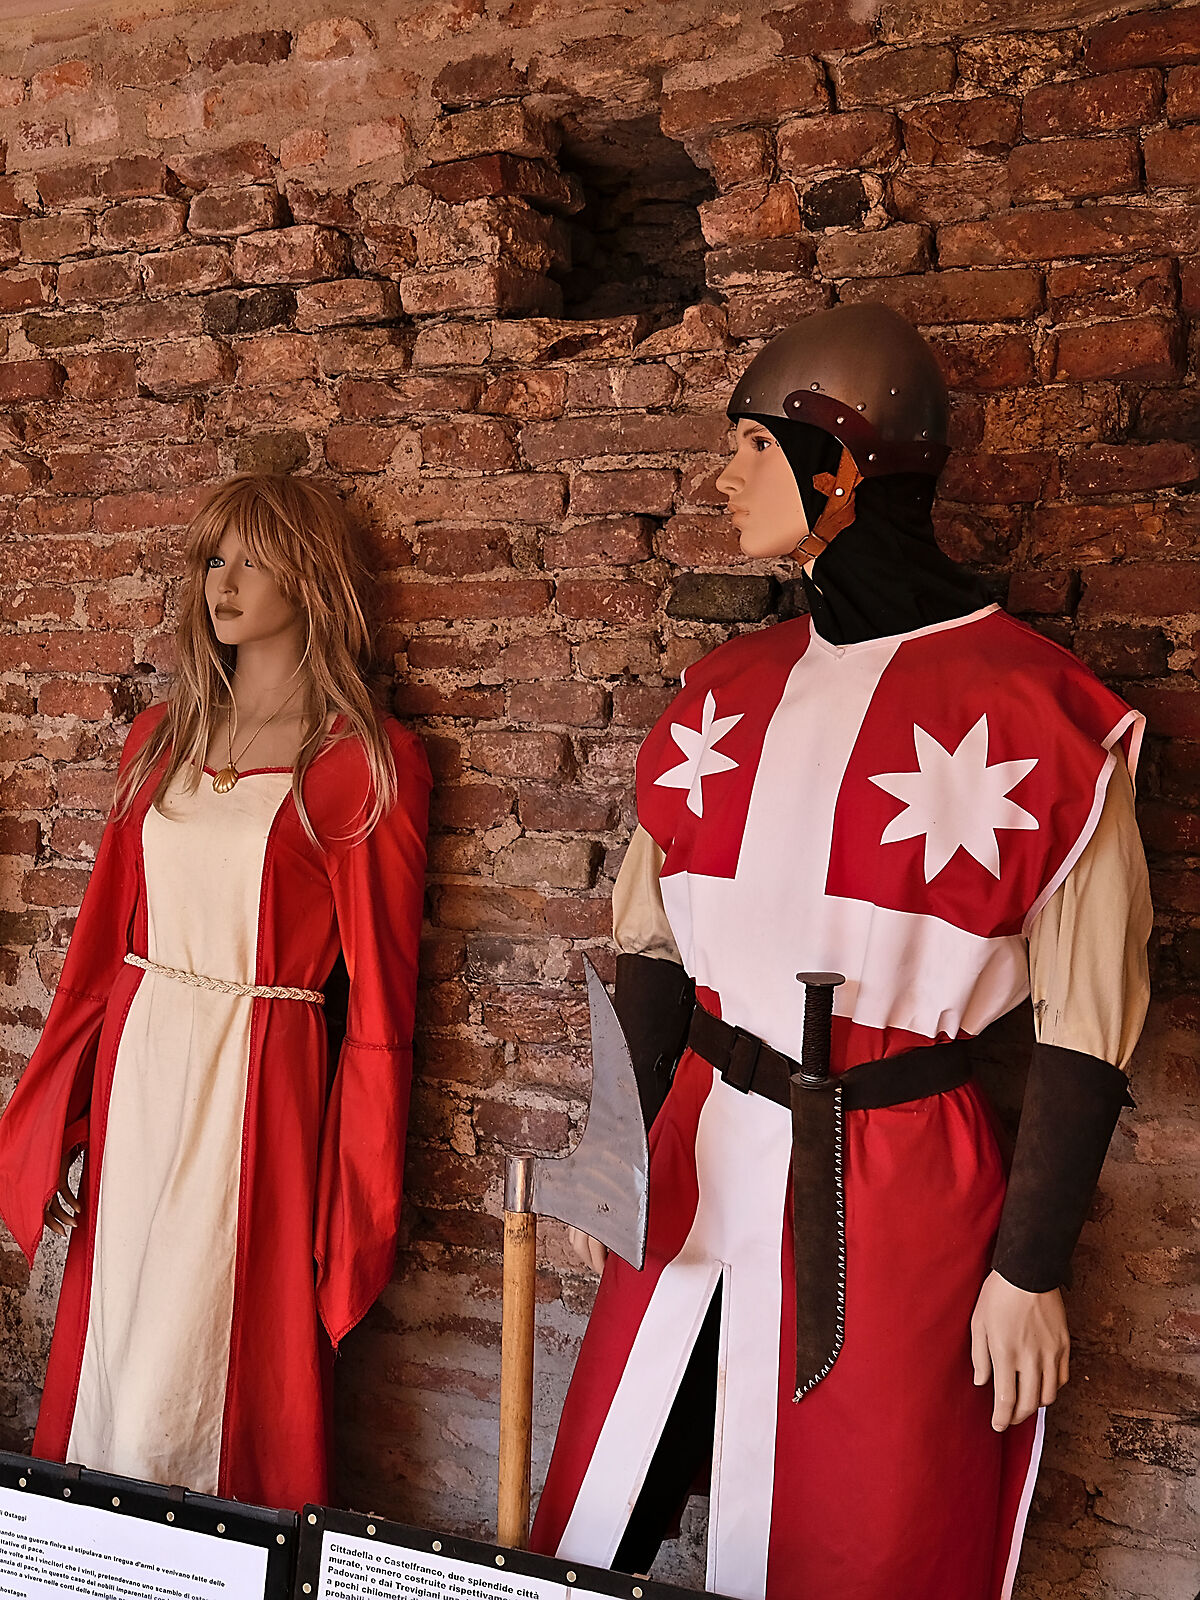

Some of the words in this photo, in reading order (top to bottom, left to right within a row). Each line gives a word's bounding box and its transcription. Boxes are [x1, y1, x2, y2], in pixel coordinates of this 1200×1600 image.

[4, 1511, 27, 1522] Ostaggi
[27, 1546, 45, 1555] pace.
[28, 1537, 49, 1546] guerra
[49, 1540, 67, 1550] finiva
[74, 1548, 103, 1559] stipulava
[113, 1556, 134, 1566] tregua
[161, 1568, 191, 1579] venivano
[191, 1574, 208, 1584] fatte
[208, 1578, 226, 1588] delle
[8, 1551, 24, 1559] volte
[25, 1554, 34, 1562] sia
[39, 1558, 64, 1569] vincitori
[64, 1564, 77, 1572] che
[81, 1568, 97, 1578] vinti,
[142, 1583, 154, 1591] uno
[155, 1586, 183, 1597] scambio
[23, 1564, 40, 1574] pace,
[48, 1570, 70, 1580] questo
[70, 1576, 86, 1584] caso
[97, 1582, 115, 1591] nobili
[24, 1574, 43, 1583] vivere
[43, 1579, 59, 1587] nelle
[59, 1583, 75, 1591] corti
[75, 1586, 91, 1595] delle
[327, 1565, 368, 1582] Padovani
[378, 1578, 393, 1588] dai
[395, 1581, 441, 1600] Trevigiani
[328, 1556, 363, 1571] murate,
[365, 1565, 402, 1579] vennero
[404, 1574, 447, 1590] costruite
[330, 1543, 374, 1561] Cittadella
[384, 1556, 445, 1579] Castelfranco,
[447, 1571, 466, 1583] due
[468, 1577, 514, 1594] splendide
[516, 1588, 539, 1600] città
[0, 1586, 27, 1598] hostages
[334, 1580, 359, 1592] pochi
